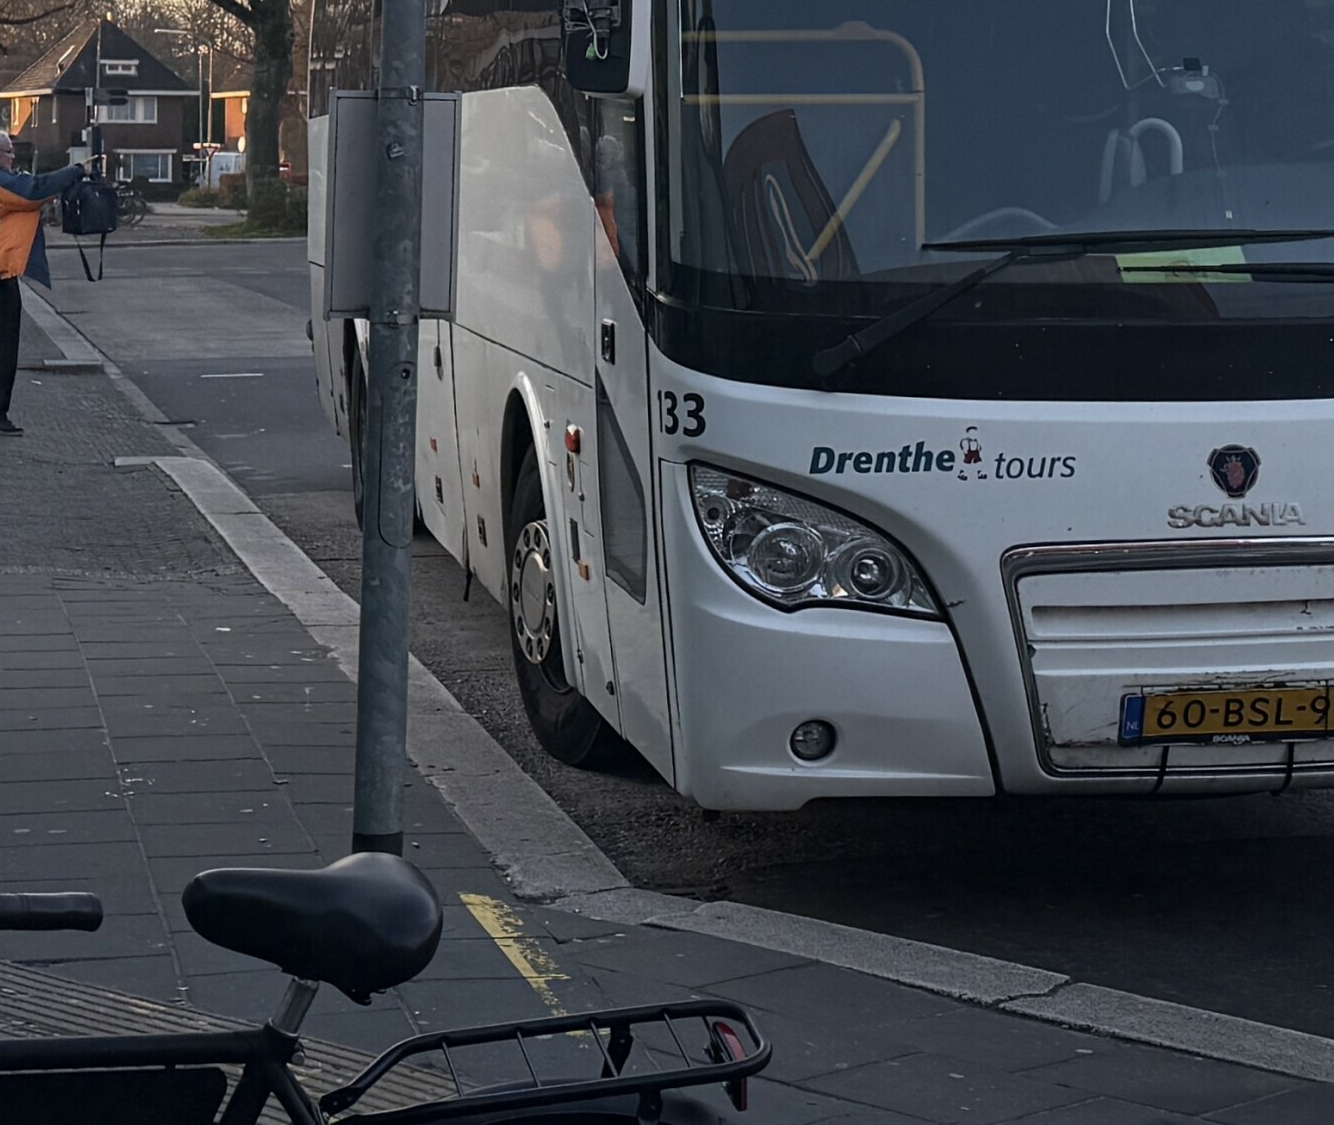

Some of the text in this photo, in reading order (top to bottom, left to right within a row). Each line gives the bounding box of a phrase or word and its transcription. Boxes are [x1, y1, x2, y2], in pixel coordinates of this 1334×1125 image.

[657, 390, 706, 437] 133
[809, 442, 1077, 479] Drenthe tours
[1167, 502, 1306, 528] SCANIA
[1126, 720, 1140, 731] NL
[1156, 695, 1331, 730] 60-BSL-9
